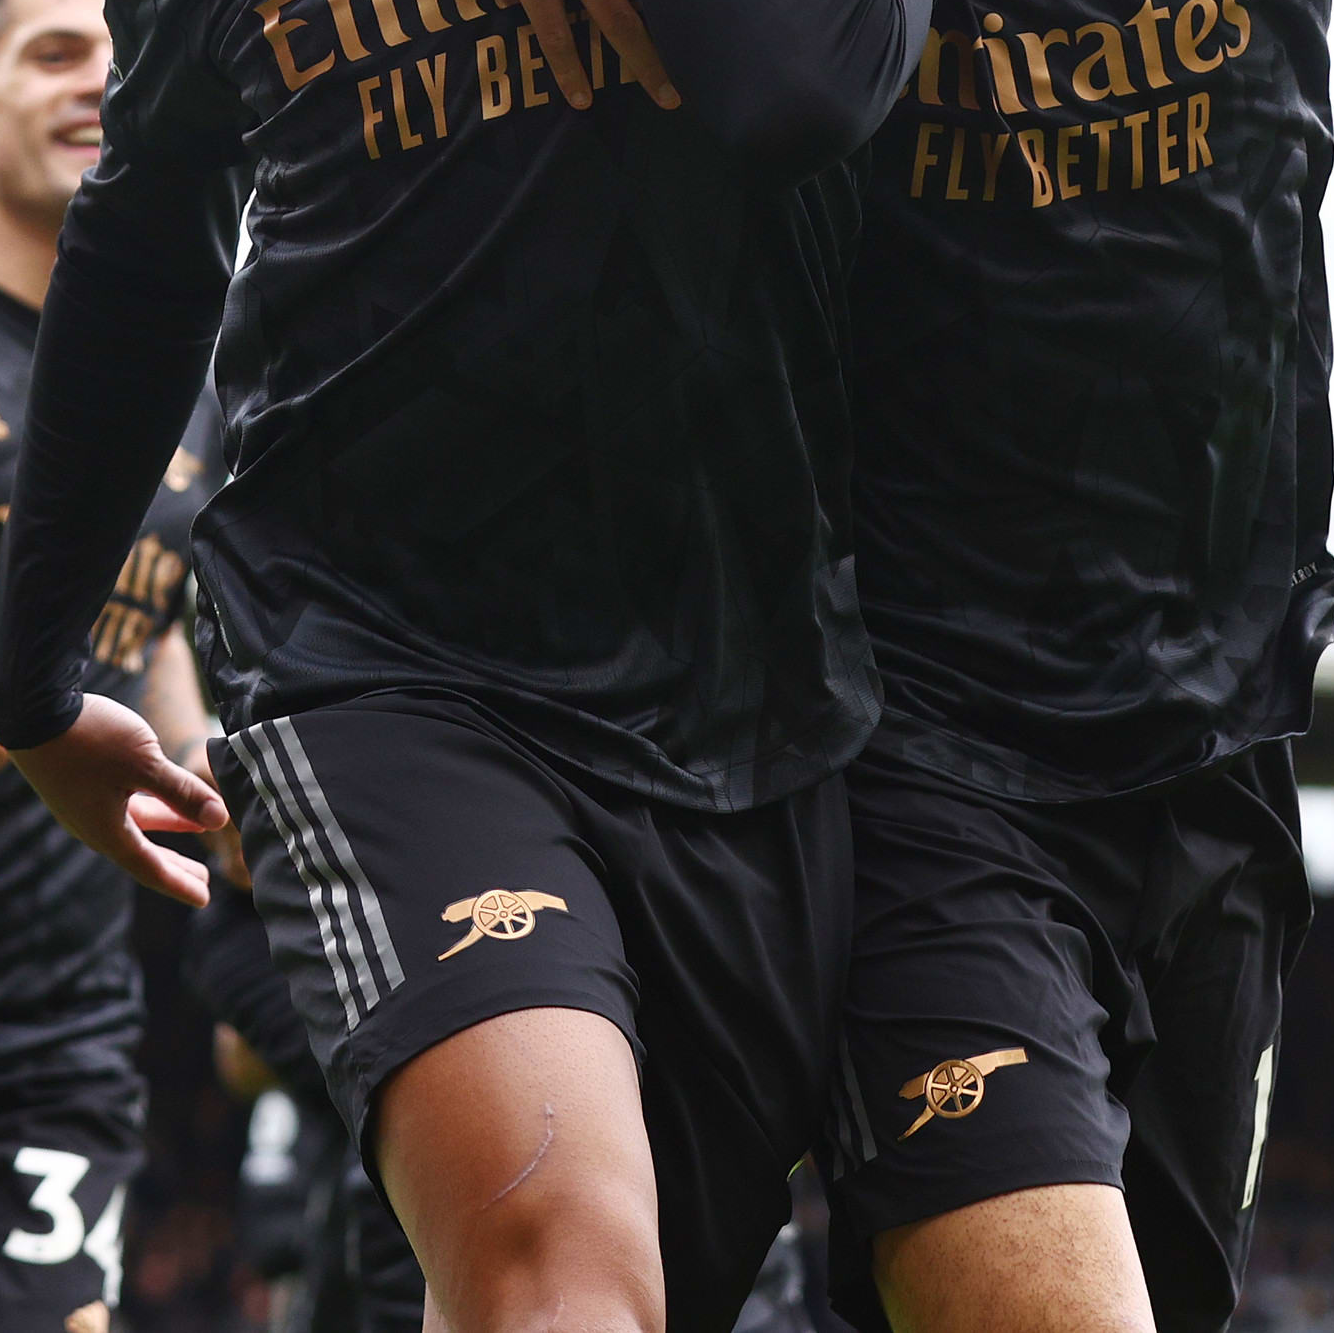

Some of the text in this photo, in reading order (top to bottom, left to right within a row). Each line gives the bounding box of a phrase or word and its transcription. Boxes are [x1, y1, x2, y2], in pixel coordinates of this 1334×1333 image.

[357, 52, 449, 160] FLY
[910, 91, 1214, 209] FLY BETTER
